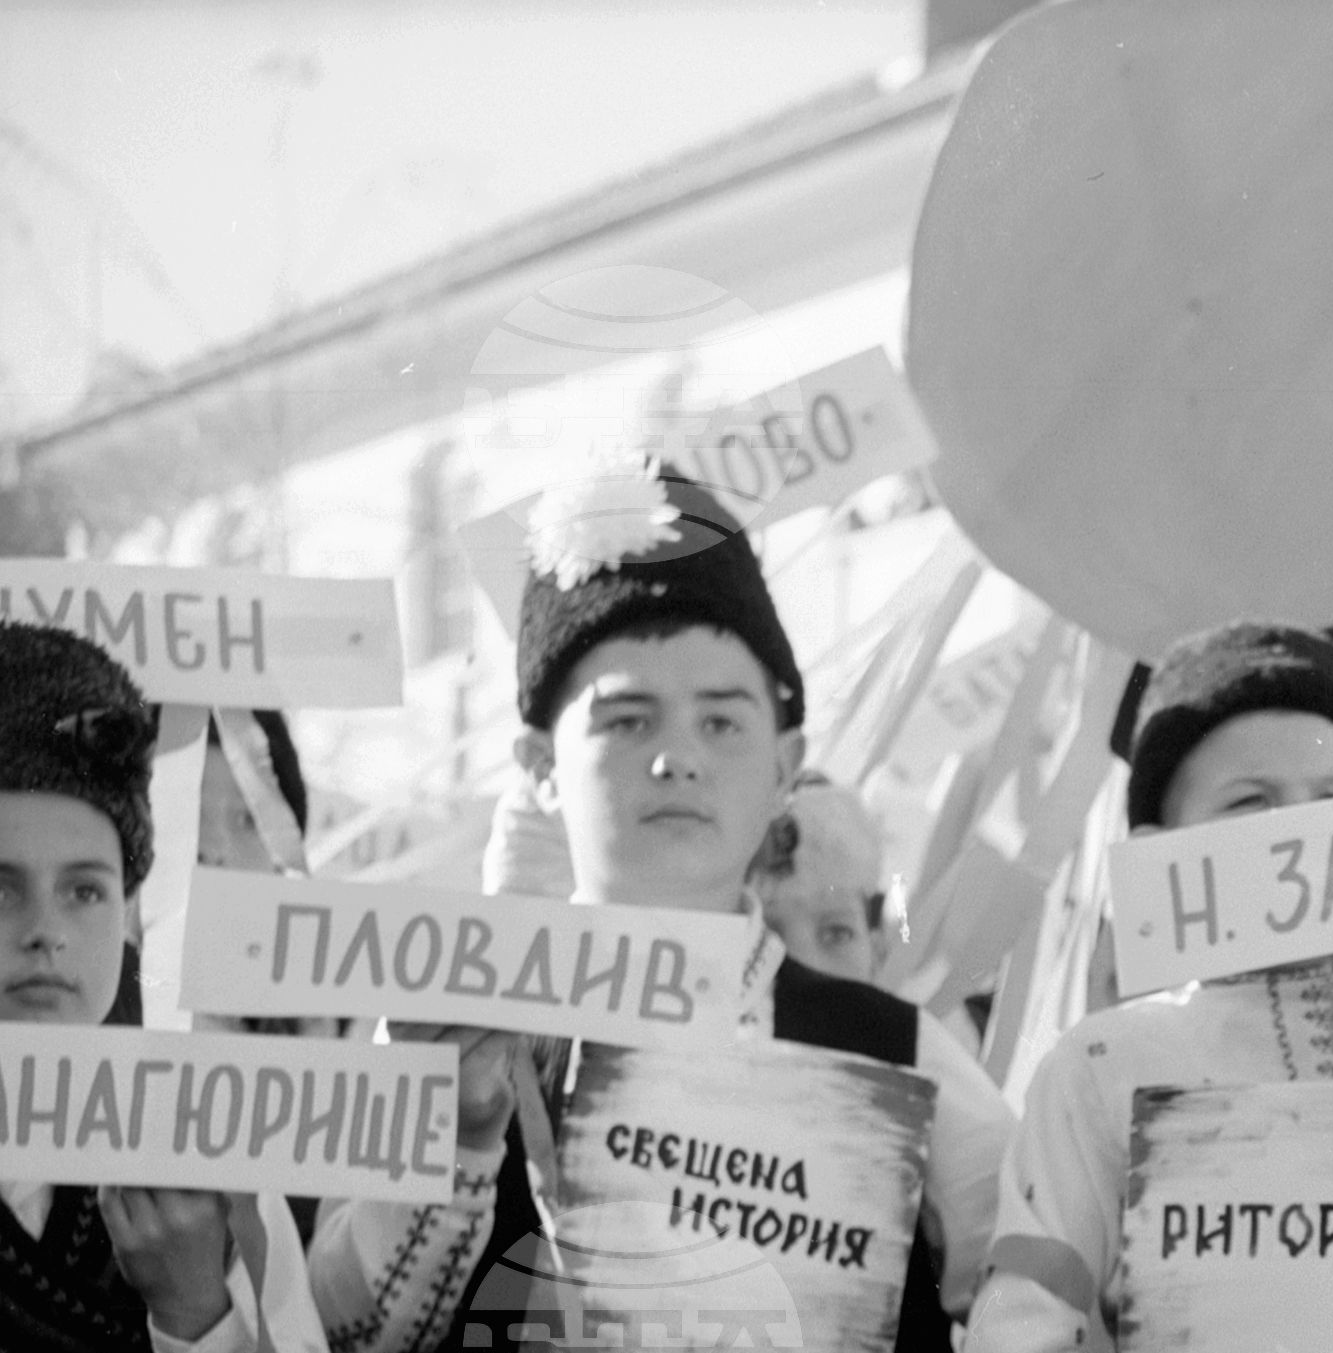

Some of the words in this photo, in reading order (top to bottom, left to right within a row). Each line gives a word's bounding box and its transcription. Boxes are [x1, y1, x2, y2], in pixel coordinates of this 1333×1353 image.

[270, 904, 696, 1026] ПЛОВДИВ
[0, 1054, 453, 1182] НАГЮРИЩЕ
[605, 1123, 810, 1200] СВЕЩЕНА
[668, 1186, 878, 1270] ИСТОРИЯ
